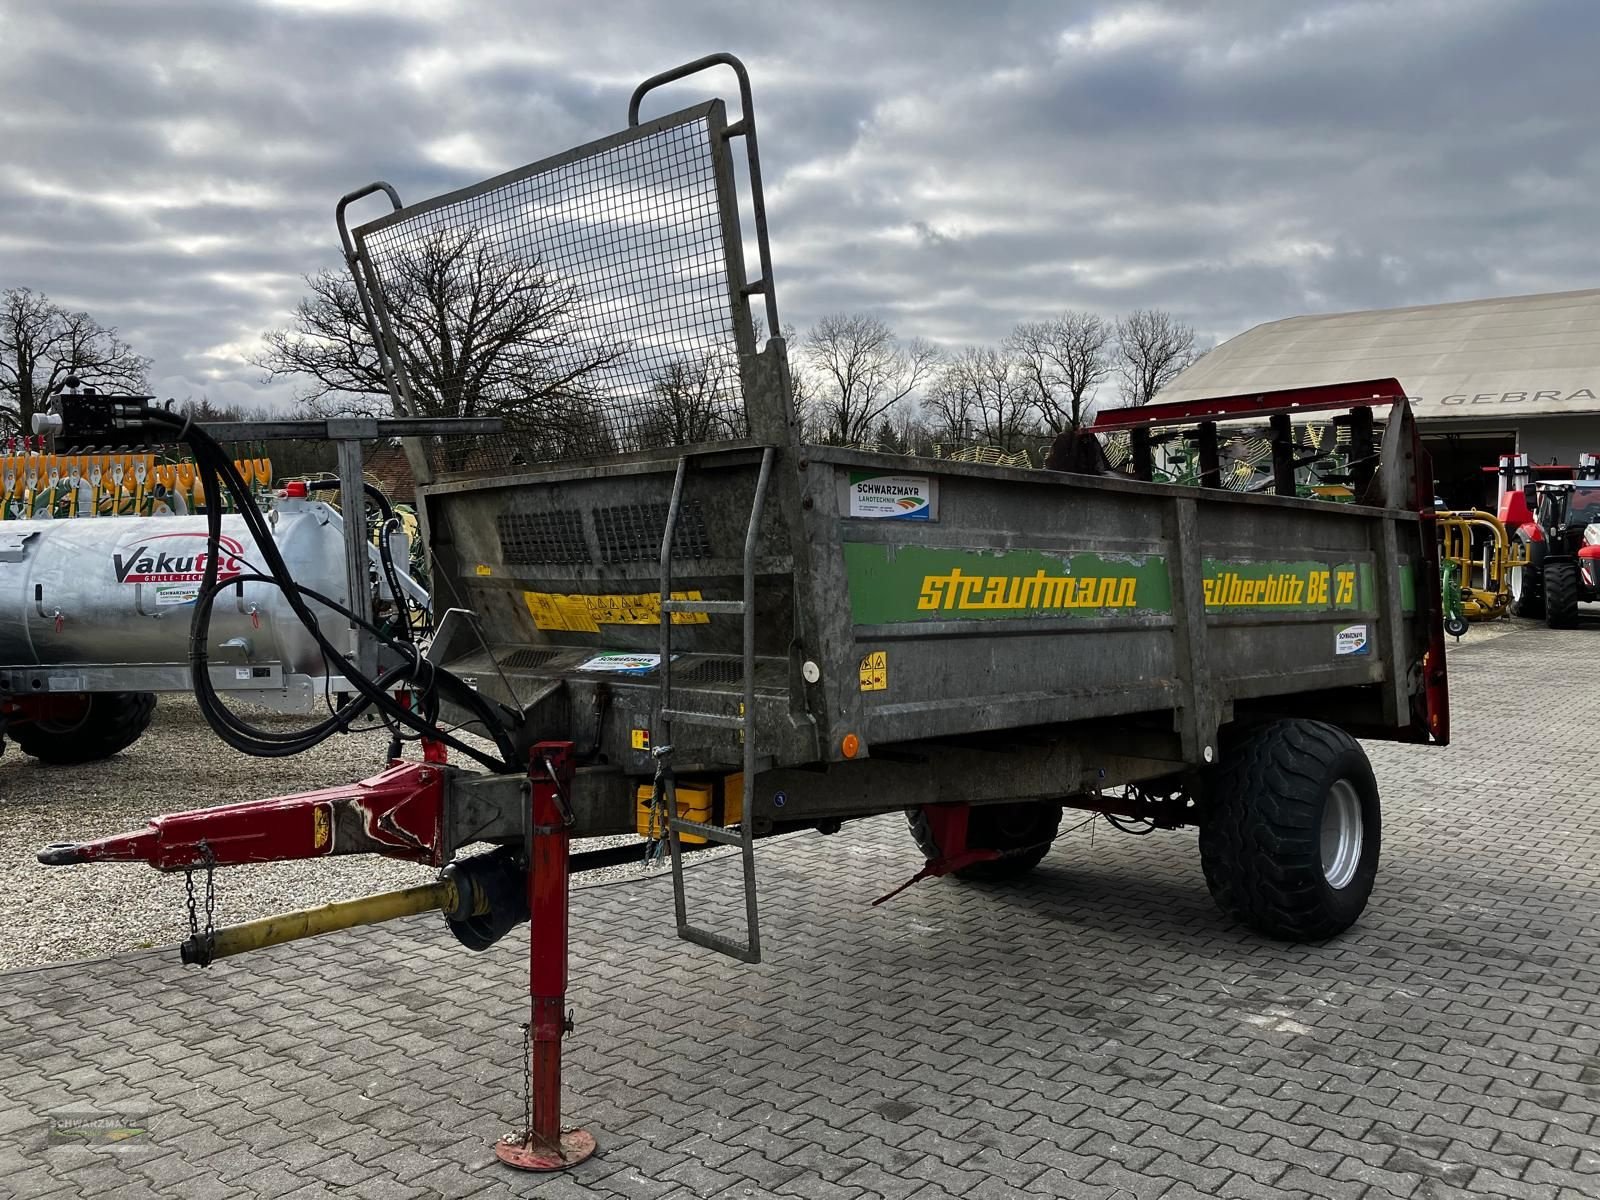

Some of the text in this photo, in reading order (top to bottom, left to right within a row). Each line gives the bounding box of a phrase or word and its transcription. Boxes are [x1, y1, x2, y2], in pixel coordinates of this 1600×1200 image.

[857, 483, 919, 496] SCHWARZMAYR
[858, 496, 896, 504] LANDTECHNIK
[113, 546, 243, 583] Vakutec
[917, 568, 1137, 610] strautmann
[1202, 571, 1355, 606] silberblitz BE 75
